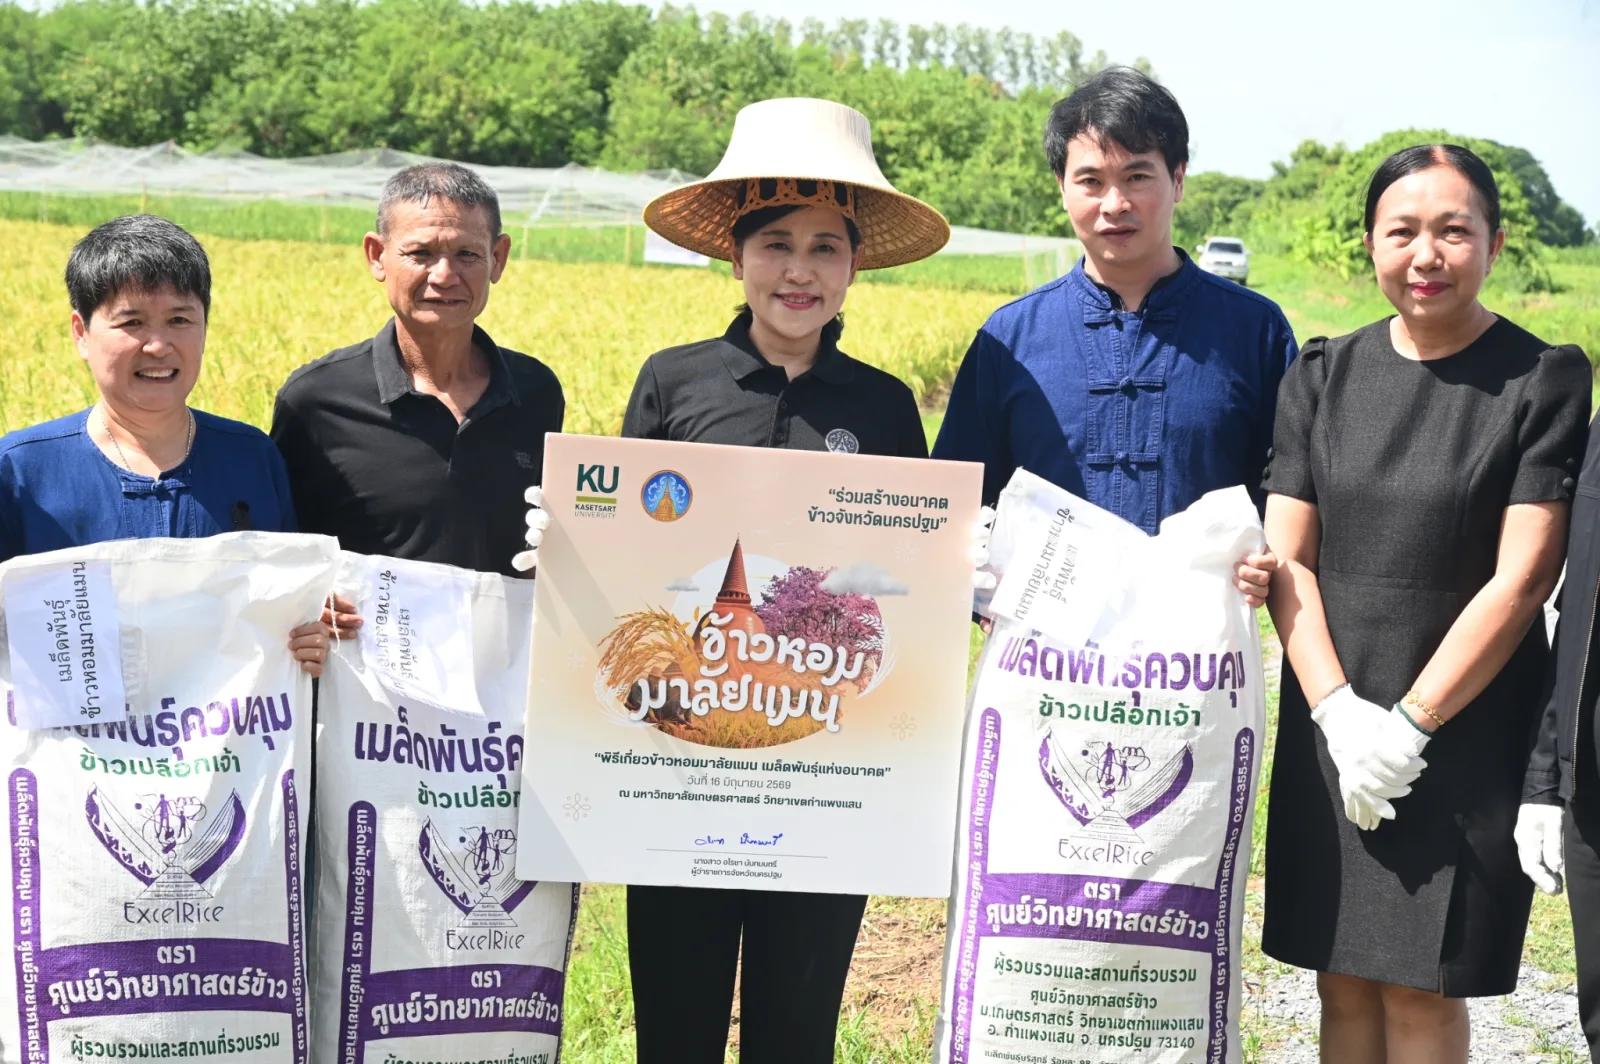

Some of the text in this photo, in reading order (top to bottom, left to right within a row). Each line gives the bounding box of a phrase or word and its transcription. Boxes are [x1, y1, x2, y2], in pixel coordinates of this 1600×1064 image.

[576, 464, 620, 493] KU
[574, 503, 617, 513] KASETSART
[828, 486, 949, 510] “ร่วมสร้างอนาคต
[574, 510, 616, 520] UNIVERSITY
[807, 505, 948, 533] ข้าวจังหวัดนครปฐม”
[44, 599, 73, 682] เมล็ดพันธุ์
[71, 560, 101, 719] ข้าวหอมมาลัยแมน
[700, 611, 865, 686] ข้าวหอม
[629, 663, 841, 732] มาลัยแมน
[1039, 694, 1201, 727] ข้าวเปลือกเจ้า
[79, 747, 241, 777] ข้าวเปลือกเจ้า
[594, 749, 891, 777] “พิธีเกี่ยวข้าวหอมมาลัยแมน เมล็ดพันธุ์แห่งอนาคต”
[687, 773, 792, 790] วันที่ 16 มิถุนายน 2569
[619, 789, 862, 809] ณ มหาวิทยาลัยเกษตรศาสตร์ วิทยาเขตกำแพงแสน
[973, 831, 984, 856] ตรา
[1058, 838, 1154, 866] ExcelRice
[1217, 961, 1227, 986] ตรา
[1233, 735, 1251, 823] 034-355-192
[1083, 881, 1121, 901] ตรา
[20, 906, 33, 934] ตรา
[124, 901, 225, 925] ExcelRice
[985, 895, 1210, 940] ศูนย์วิทยาศาสตร์ข้าว
[156, 944, 196, 964] ตรา
[352, 931, 364, 957] ตรา
[446, 929, 525, 951] ExcelRice
[471, 969, 501, 989] ตรา
[994, 951, 1197, 983] ผู้รวบรวมและสถานที่รวบรวม
[17, 940, 45, 1064] ศูนย์วิทยาศาสตร์
[47, 967, 288, 1014] ศูนย์วิทยาศาสตร์ข้าว
[1030, 987, 1158, 1010] ศูนย์วิทยาศาสตร์ข้าว
[371, 991, 560, 1034] ศูนย์วิทยาศาสตร์ข้าว
[980, 1005, 1204, 1031] ม.เกษตรศาสตร์ วิทยาเขตกำแพงแสน
[954, 996, 969, 1064] 034-355-1
[987, 1024, 1195, 1052] อ. กำแพงแสน จ. นครปฐม 73140
[71, 1028, 281, 1062] ผู้รวบรวมและสถานที่รวบรวม
